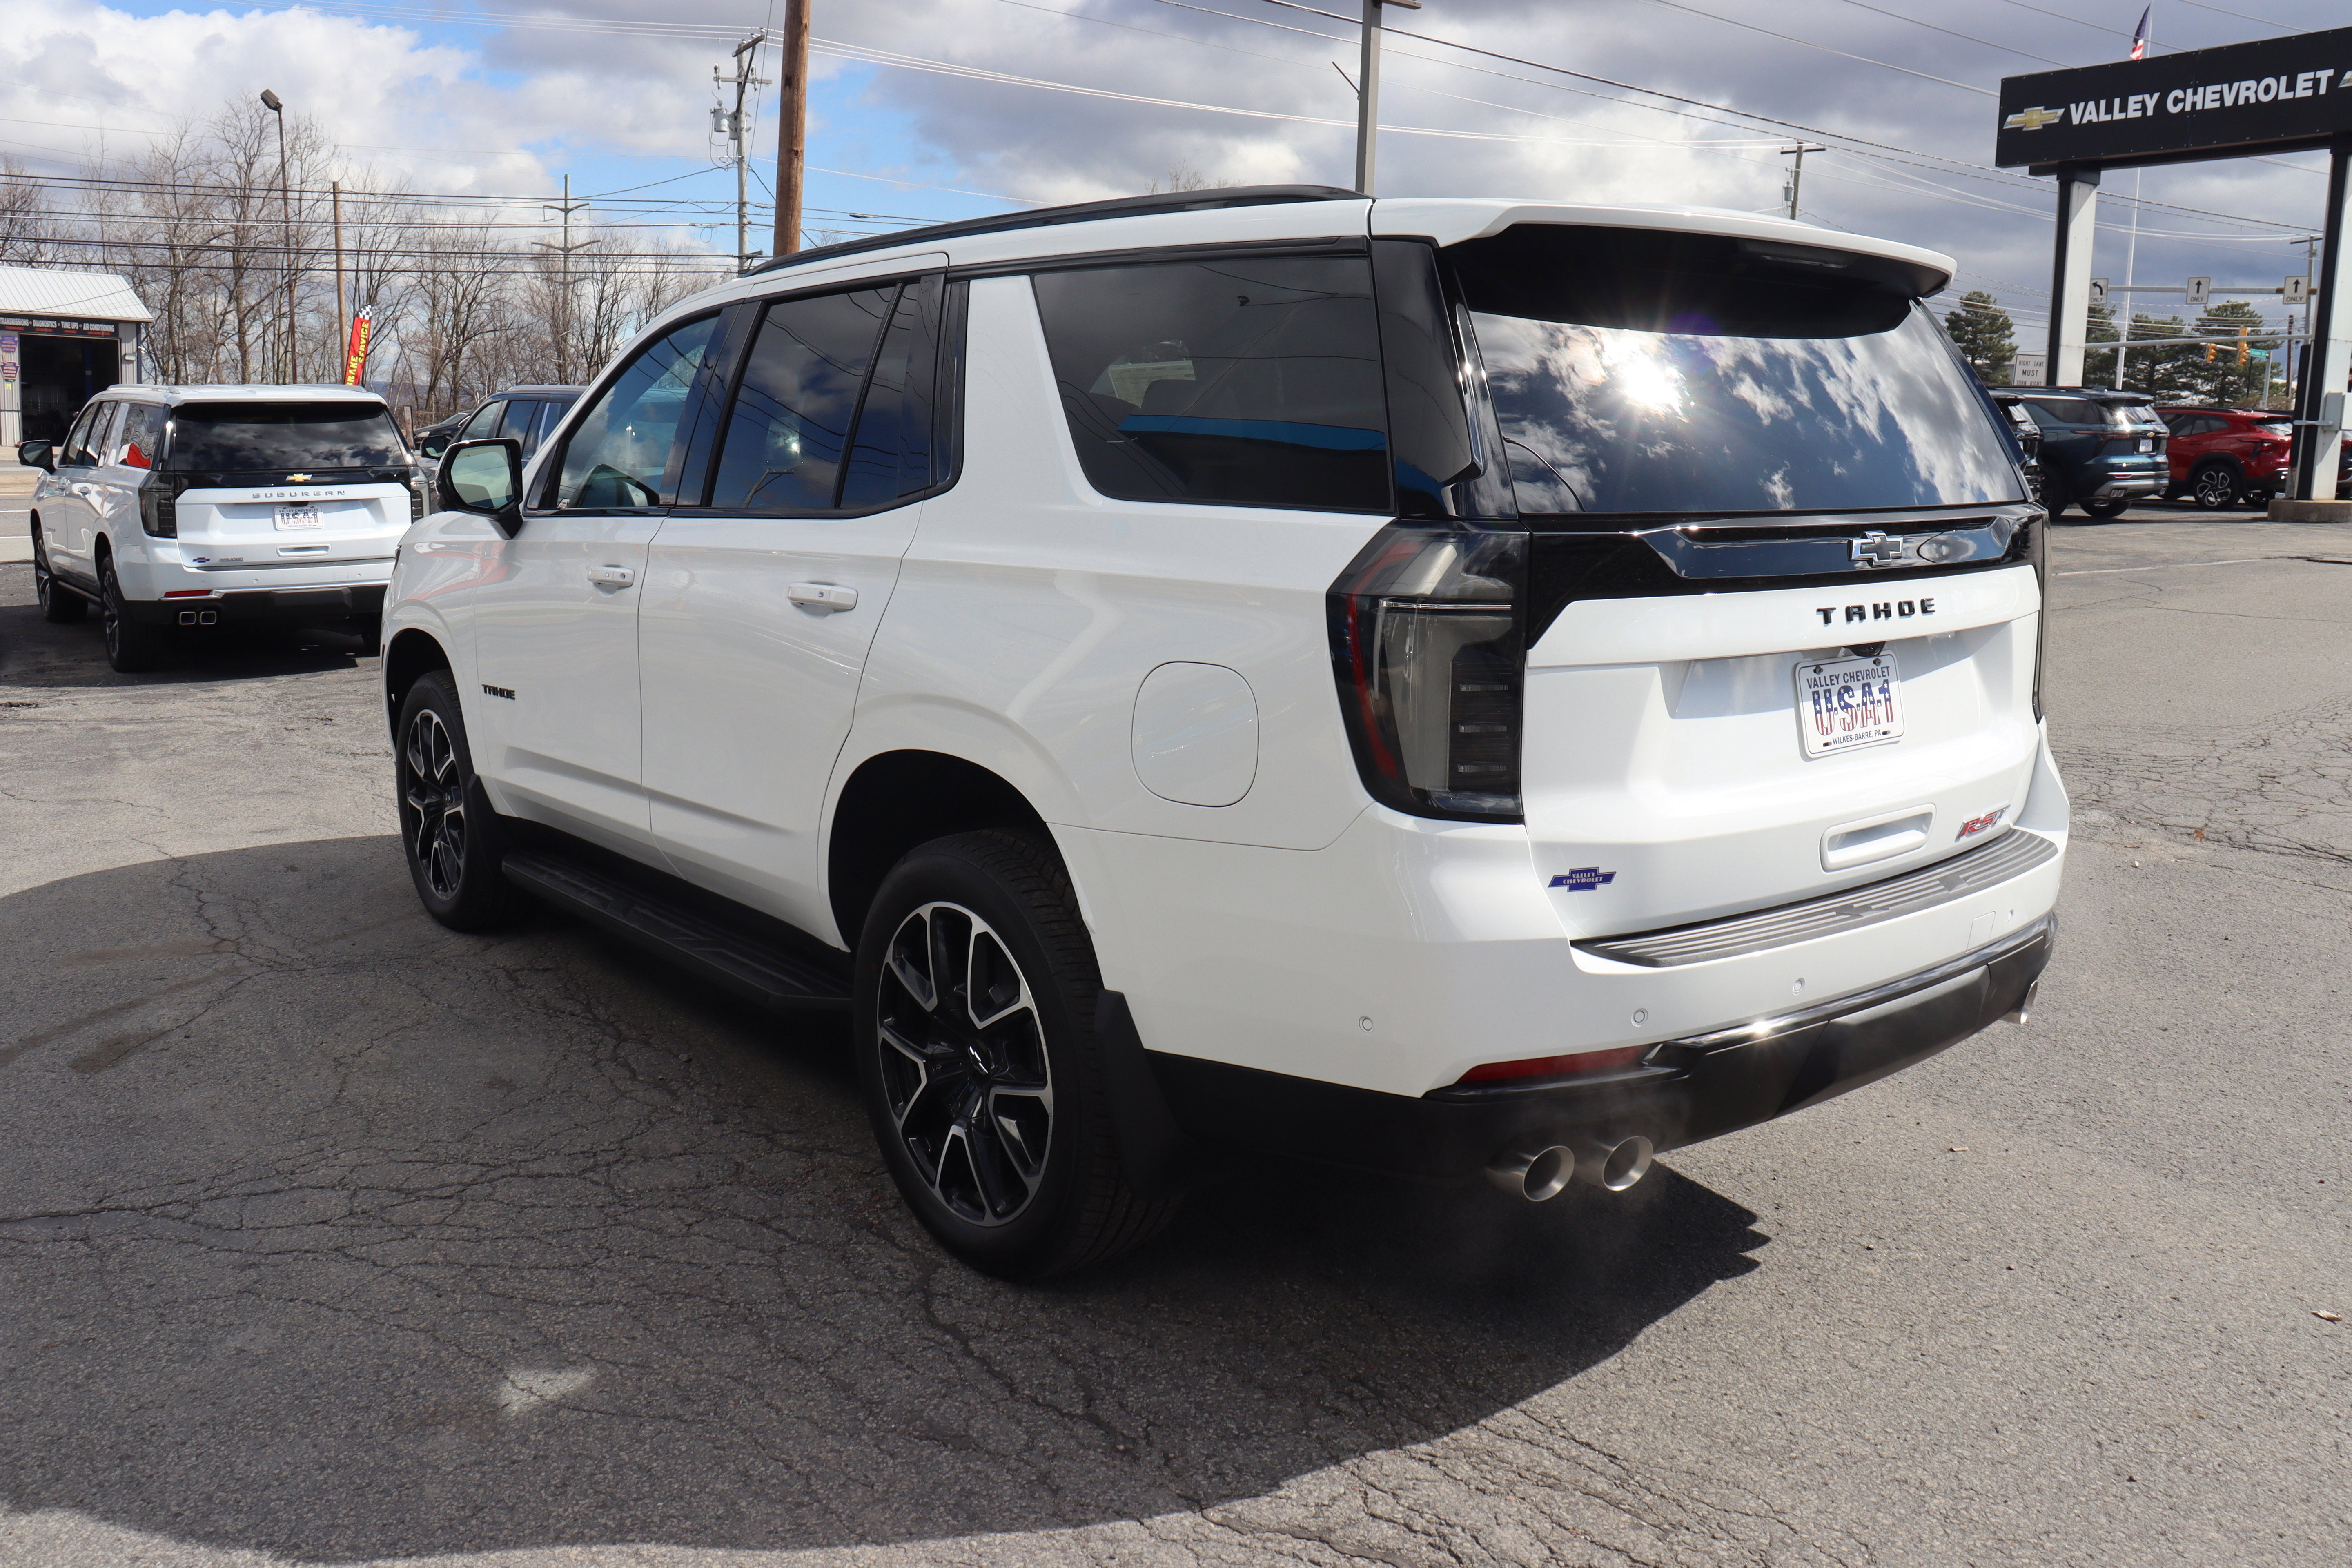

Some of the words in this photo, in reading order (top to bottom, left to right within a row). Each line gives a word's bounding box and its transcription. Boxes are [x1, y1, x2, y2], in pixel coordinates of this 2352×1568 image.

[2069, 92, 2160, 125] VALLEY
[2166, 69, 2334, 114] CHEVROLET
[0, 317, 29, 326] TRANSMISSIONS
[33, 319, 57, 328] DIAGNOSTICS
[358, 321, 369, 363] SERVICE
[252, 490, 345, 499] SUBURBAN
[1816, 597, 1936, 624] TAHOE
[1806, 674, 1840, 689] VALLEY
[1843, 666, 1890, 684] CHEVROLET
[482, 684, 515, 700] TAHOE
[1833, 731, 1873, 745] WILKES-BARRE,
[1875, 729, 1881, 737] PA
[1955, 805, 2010, 842] RST
